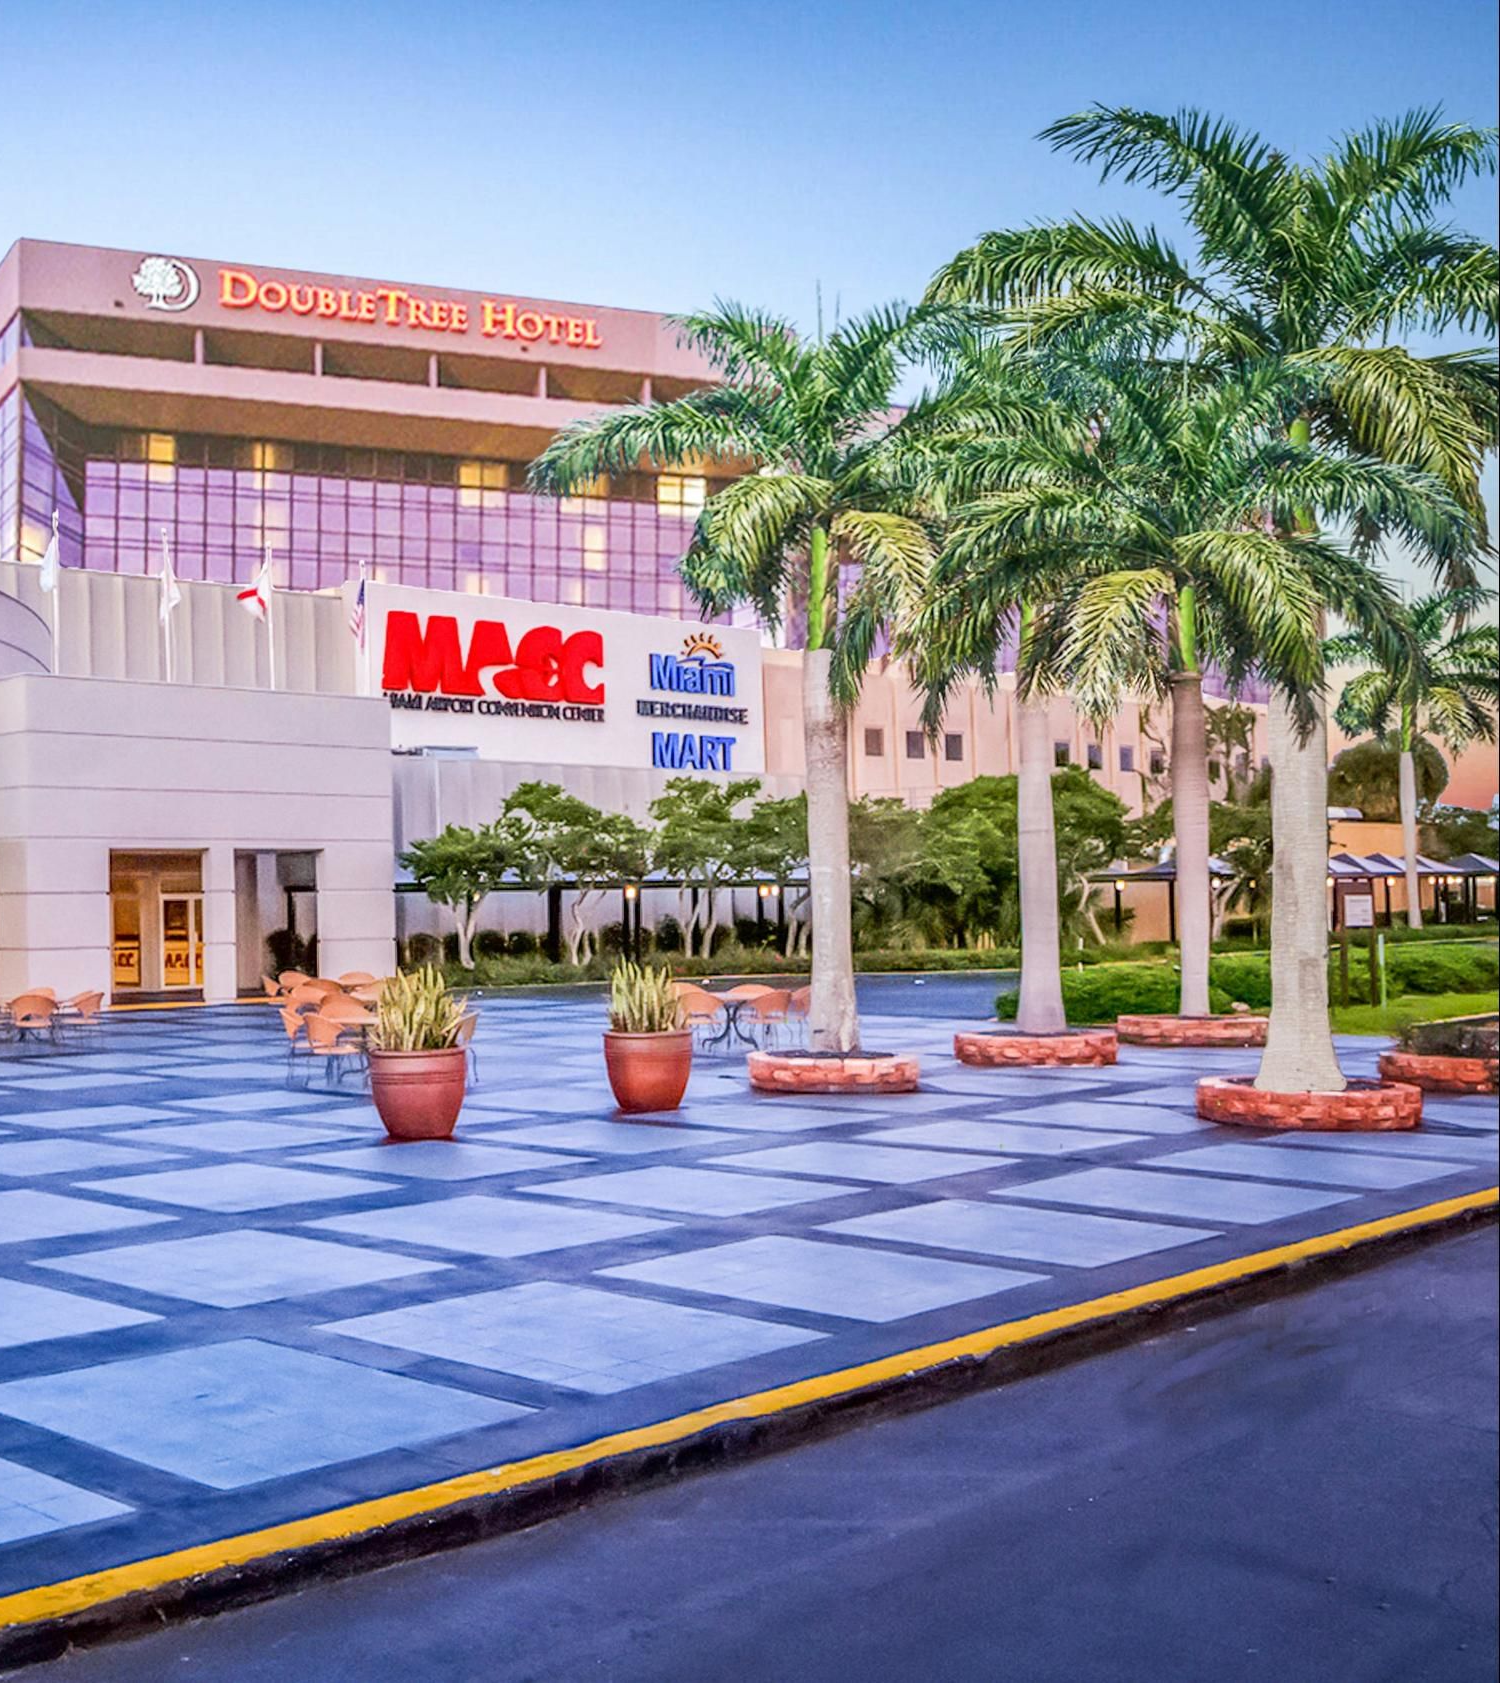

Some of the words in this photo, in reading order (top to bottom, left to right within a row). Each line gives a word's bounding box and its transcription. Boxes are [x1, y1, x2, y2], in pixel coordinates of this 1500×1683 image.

[481, 299, 602, 348] HOTEL
[382, 610, 605, 705] MACC
[649, 653, 735, 697] Miami
[425, 696, 475, 714] AIRPORT
[478, 700, 560, 720] CONVENTION
[562, 706, 604, 722] CENTER
[636, 699, 749, 725] MERCHANDISE
[652, 732, 737, 771] MART
